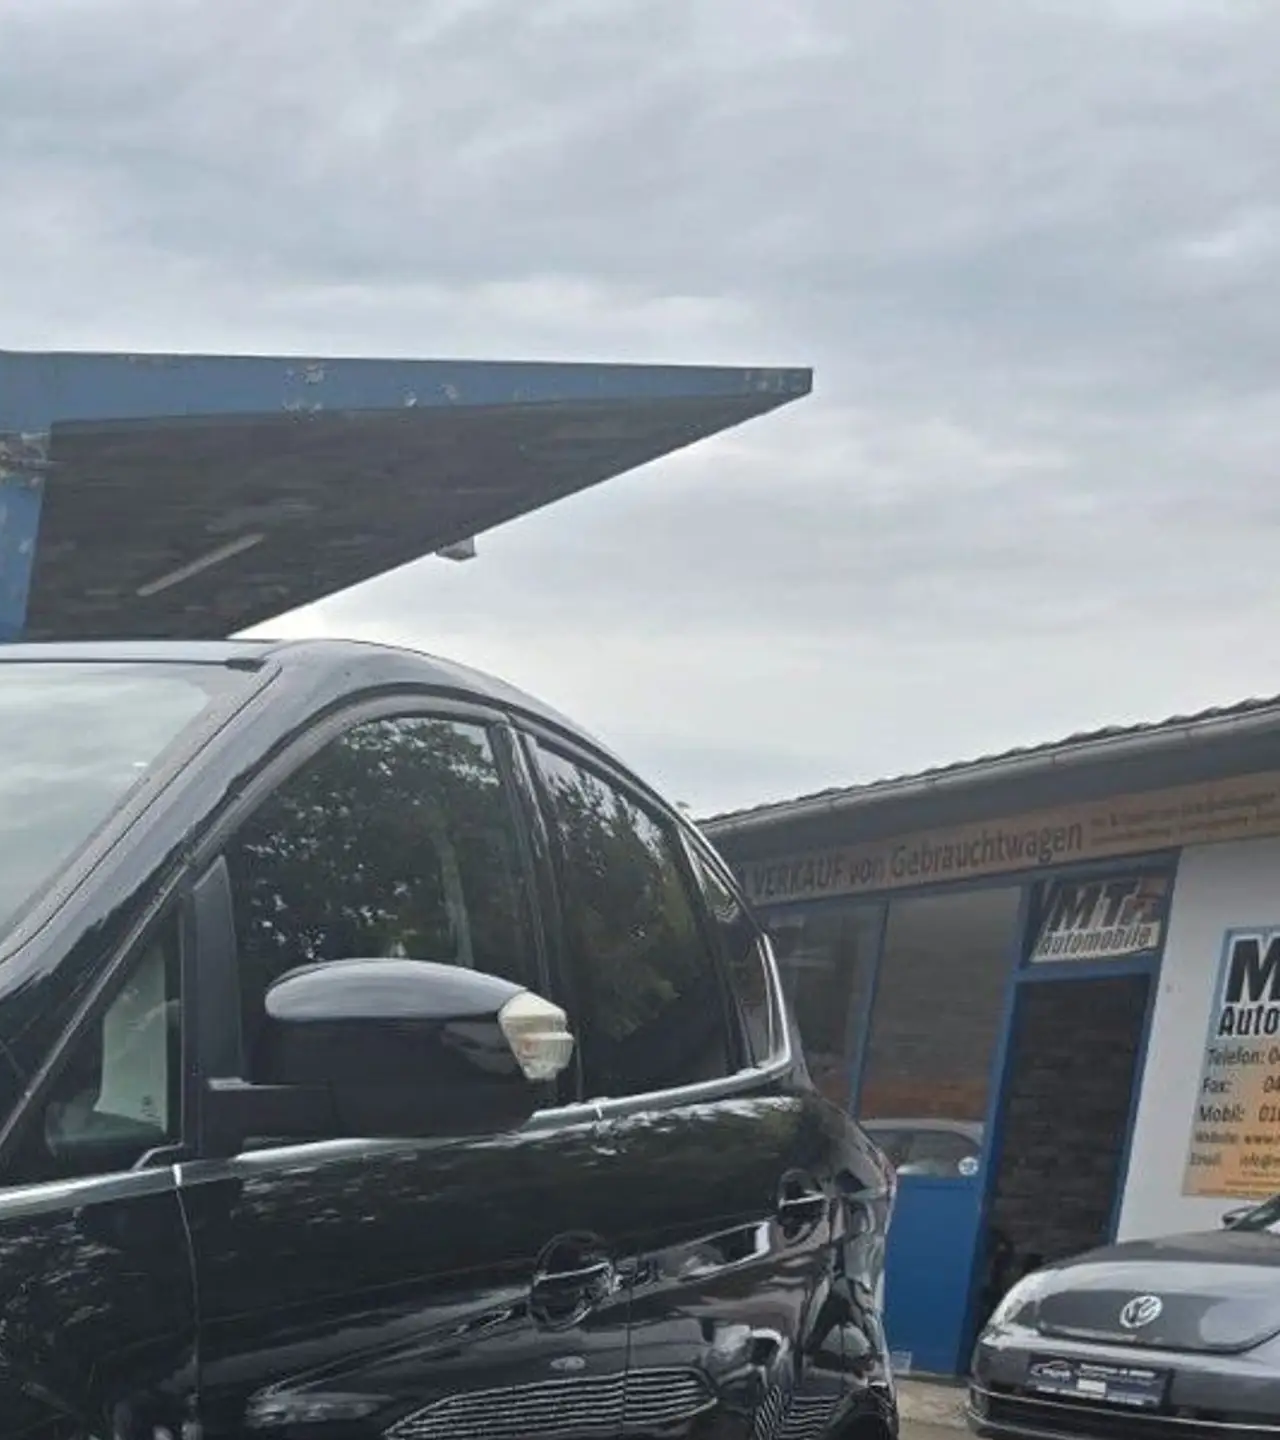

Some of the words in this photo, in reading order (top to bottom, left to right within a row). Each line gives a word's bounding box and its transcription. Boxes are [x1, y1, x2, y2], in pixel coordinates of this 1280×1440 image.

[752, 850, 846, 897] VERKAUF
[849, 858, 886, 885] von
[889, 821, 1083, 879] Gebrauchtwagen
[1218, 1003, 1280, 1036] Auto
